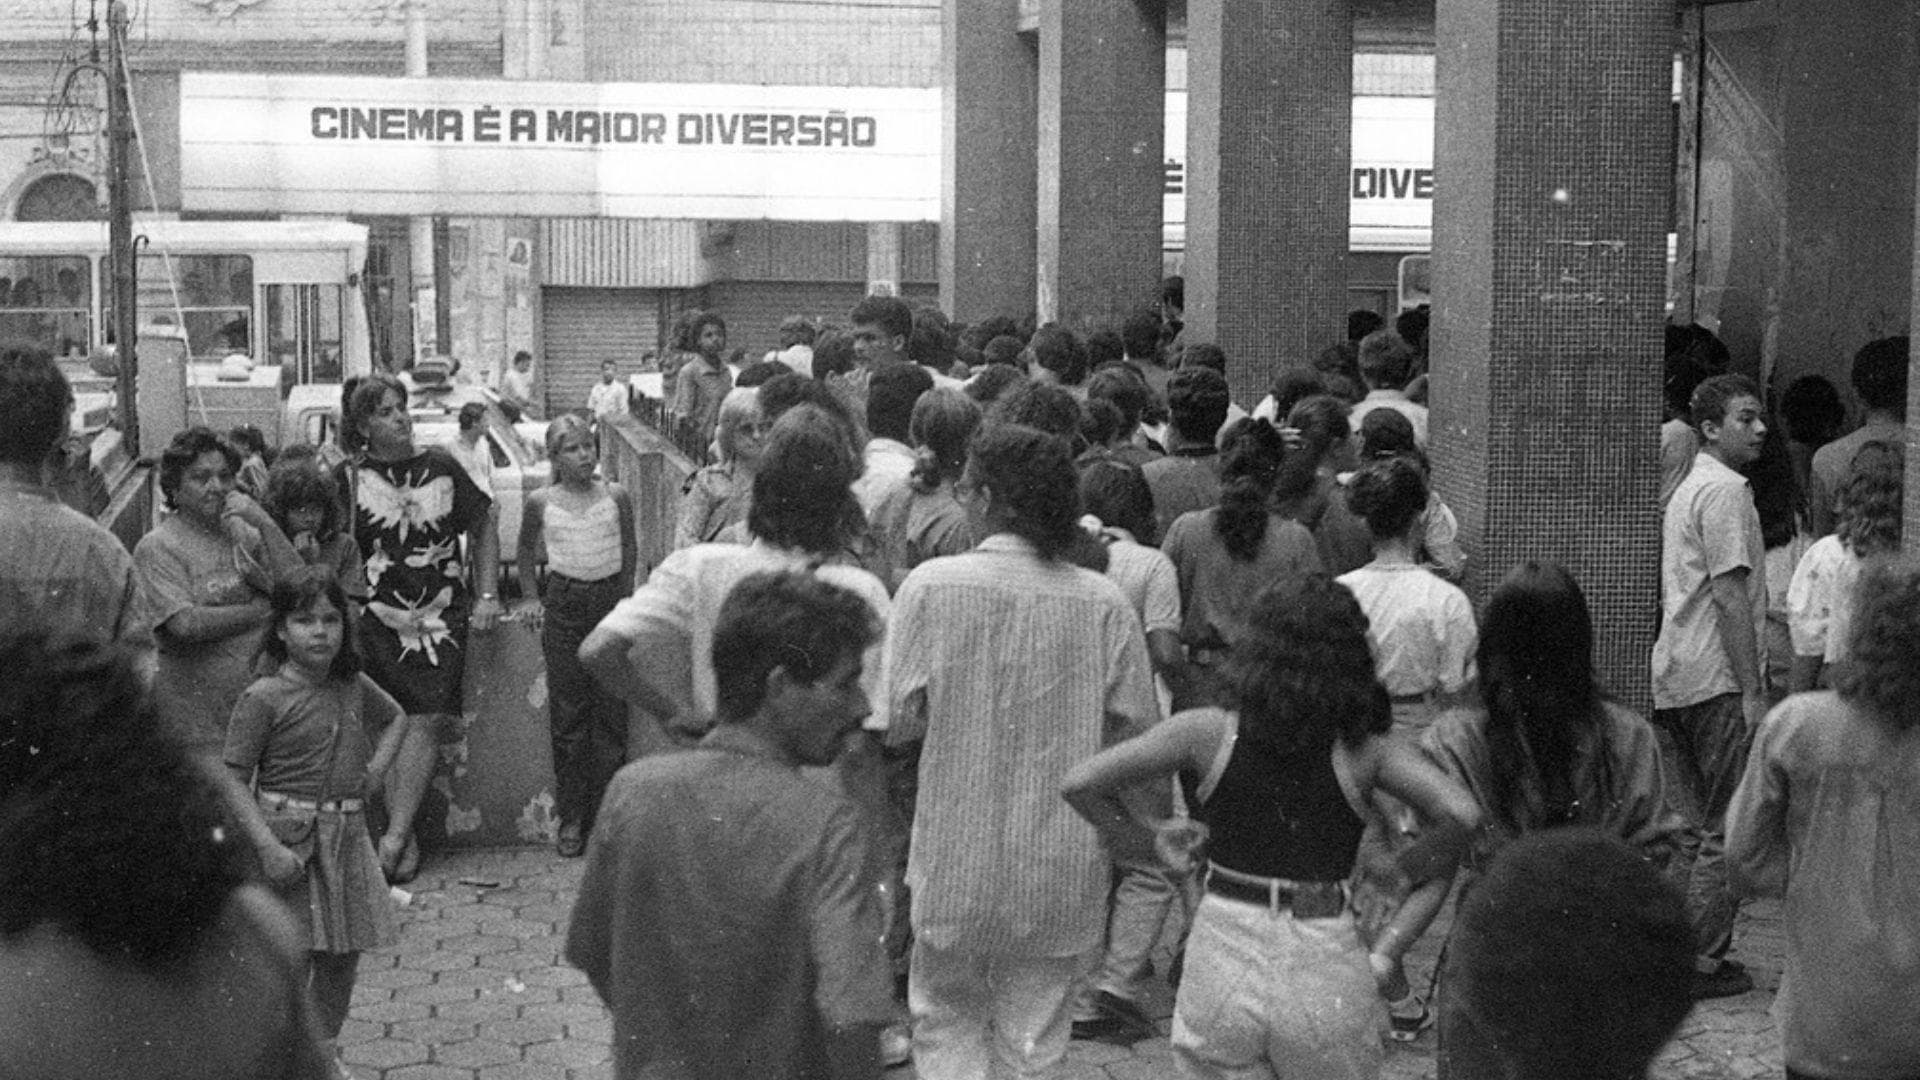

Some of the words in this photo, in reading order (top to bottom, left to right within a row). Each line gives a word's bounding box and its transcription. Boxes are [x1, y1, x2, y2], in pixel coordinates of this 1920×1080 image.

[311, 106, 463, 142] CINEMA
[474, 104, 501, 142] É
[510, 109, 536, 141] A
[547, 110, 667, 144] MAIOR
[678, 109, 876, 147] DIVERSÃO
